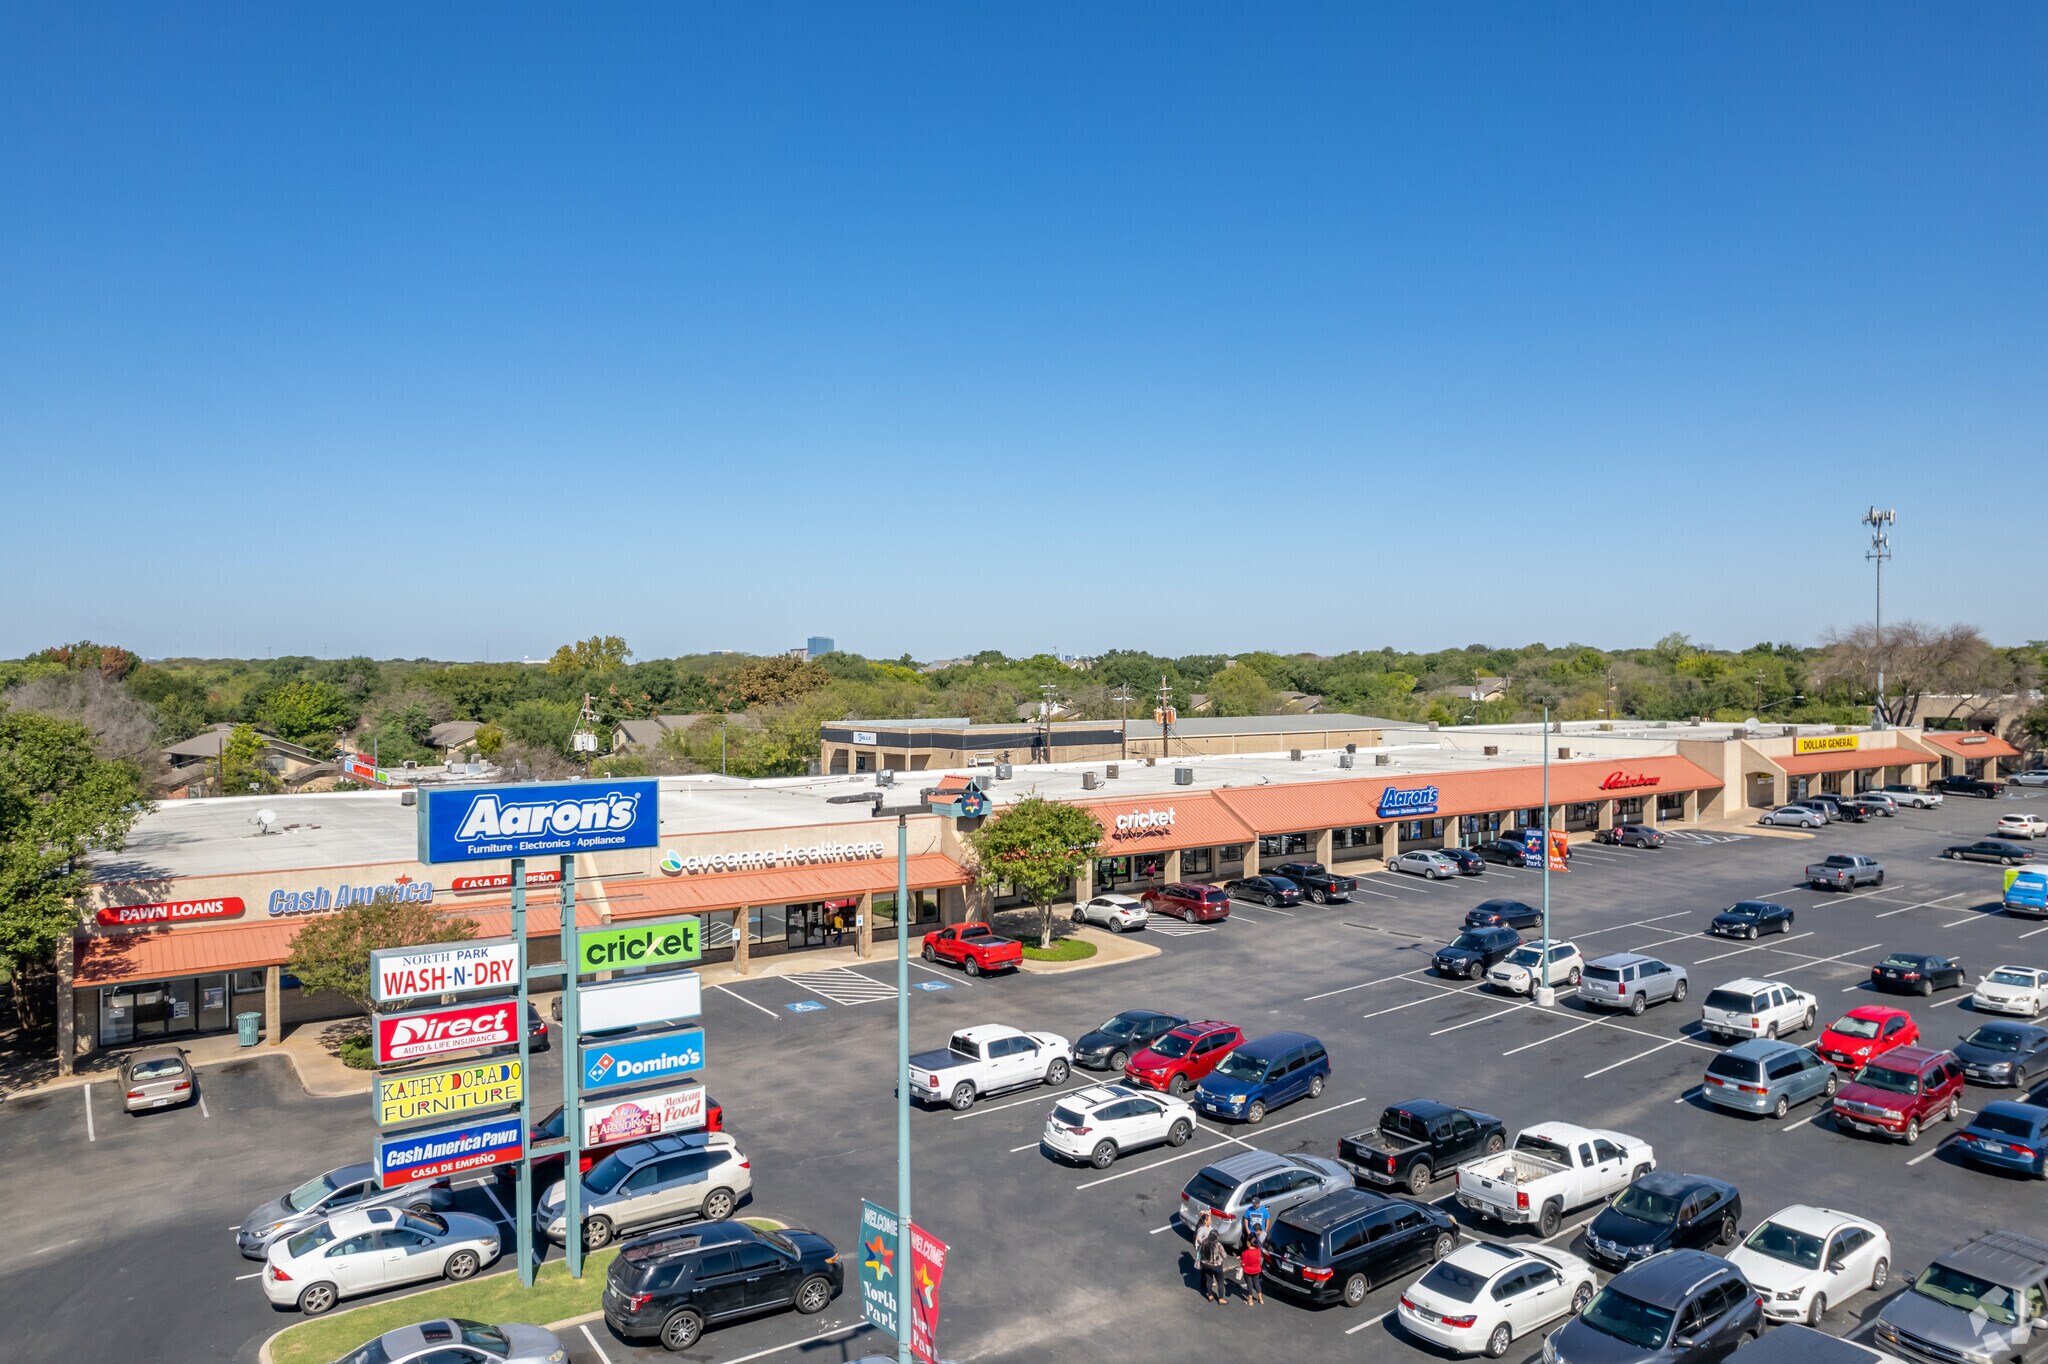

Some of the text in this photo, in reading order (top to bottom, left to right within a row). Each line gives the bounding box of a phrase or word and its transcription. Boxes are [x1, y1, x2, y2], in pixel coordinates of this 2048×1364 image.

[1803, 738, 1854, 750] DOLLAR GENERAL
[1382, 787, 1439, 808] Aaron's
[456, 792, 636, 842] Aaron's
[1115, 807, 1176, 830] cricket
[467, 835, 626, 854] Furniture Electronics Appliances
[686, 840, 884, 870] aveanna healthcare
[1526, 859, 1542, 867] Park
[462, 872, 555, 889] CASA DE PEÑO
[119, 900, 224, 922] PAWN LOANS
[268, 886, 331, 915] Cash
[402, 948, 489, 966] NORTH PARK
[586, 928, 694, 965] cricket
[383, 959, 514, 996] WASH-N-DRY
[390, 1009, 508, 1046] Direct
[404, 1044, 425, 1054] AUTO
[434, 1039, 451, 1049] LIFE
[452, 1034, 497, 1046] INSURANCE
[617, 1048, 701, 1077] Domino's
[381, 1062, 522, 1103] KATHY DORADO
[385, 1085, 517, 1121] FURNITURE
[664, 1091, 701, 1108] Mexican
[664, 1100, 701, 1122] Food
[482, 1128, 518, 1148] Pawn
[411, 1153, 496, 1179] CASA DE EMPEÑO
[863, 1207, 898, 1237] WELCOME
[911, 1231, 945, 1268] WELCOME
[863, 1280, 897, 1313] North
[865, 1300, 897, 1332] Park
